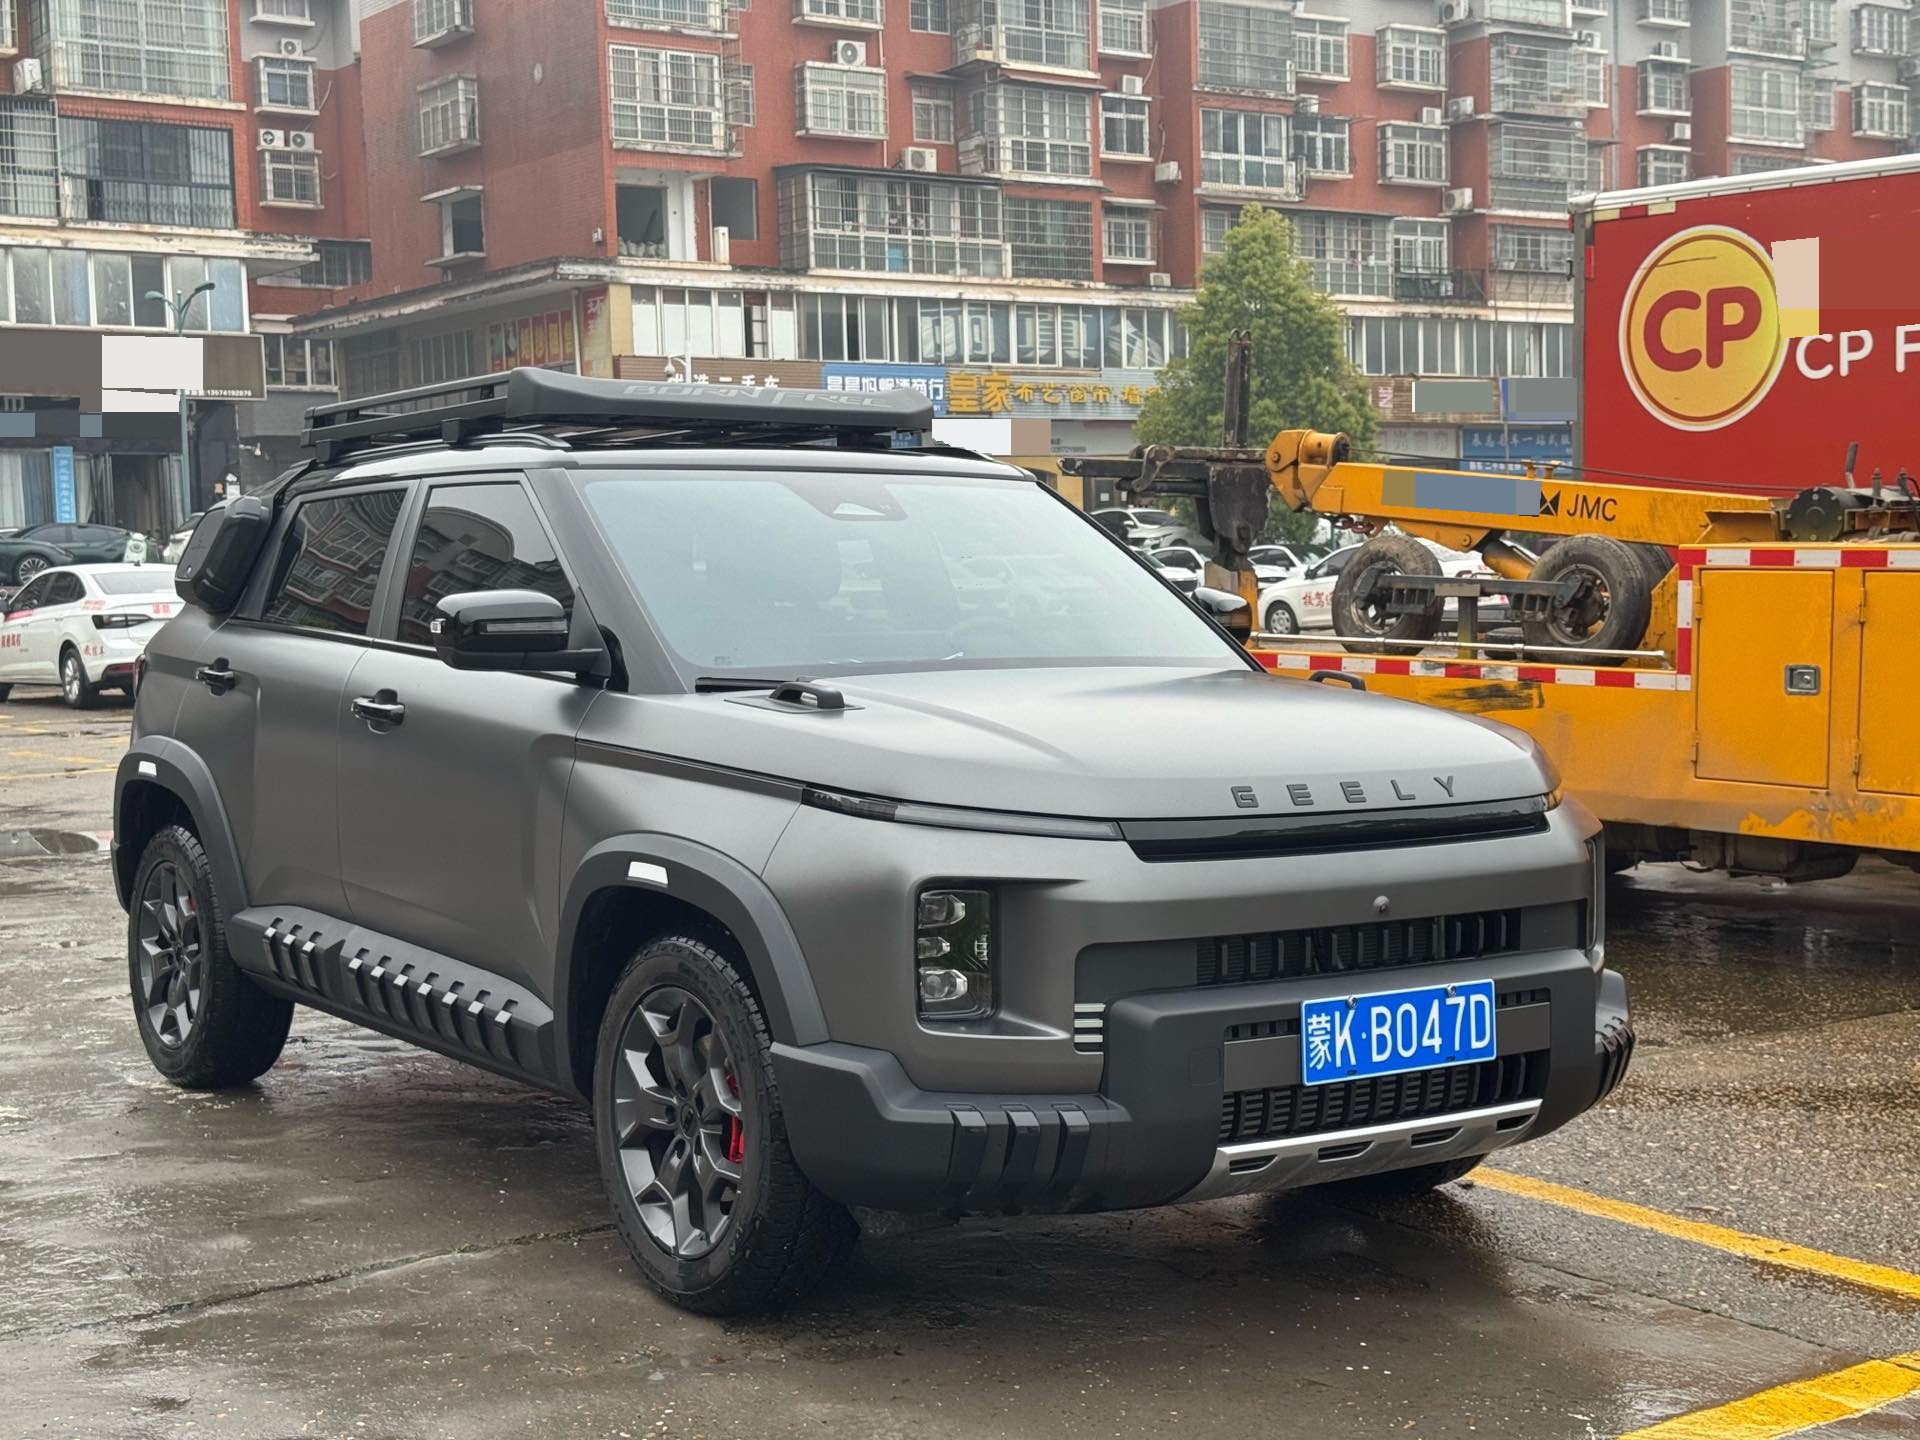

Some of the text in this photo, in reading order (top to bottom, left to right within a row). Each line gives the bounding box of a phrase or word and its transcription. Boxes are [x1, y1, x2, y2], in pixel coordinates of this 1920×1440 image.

[1643, 286, 1762, 373] CP
[1795, 329, 1874, 380] CP
[947, 370, 1011, 413] 皇家
[1566, 493, 1618, 521] JMC
[1230, 775, 1456, 809] GEELY
